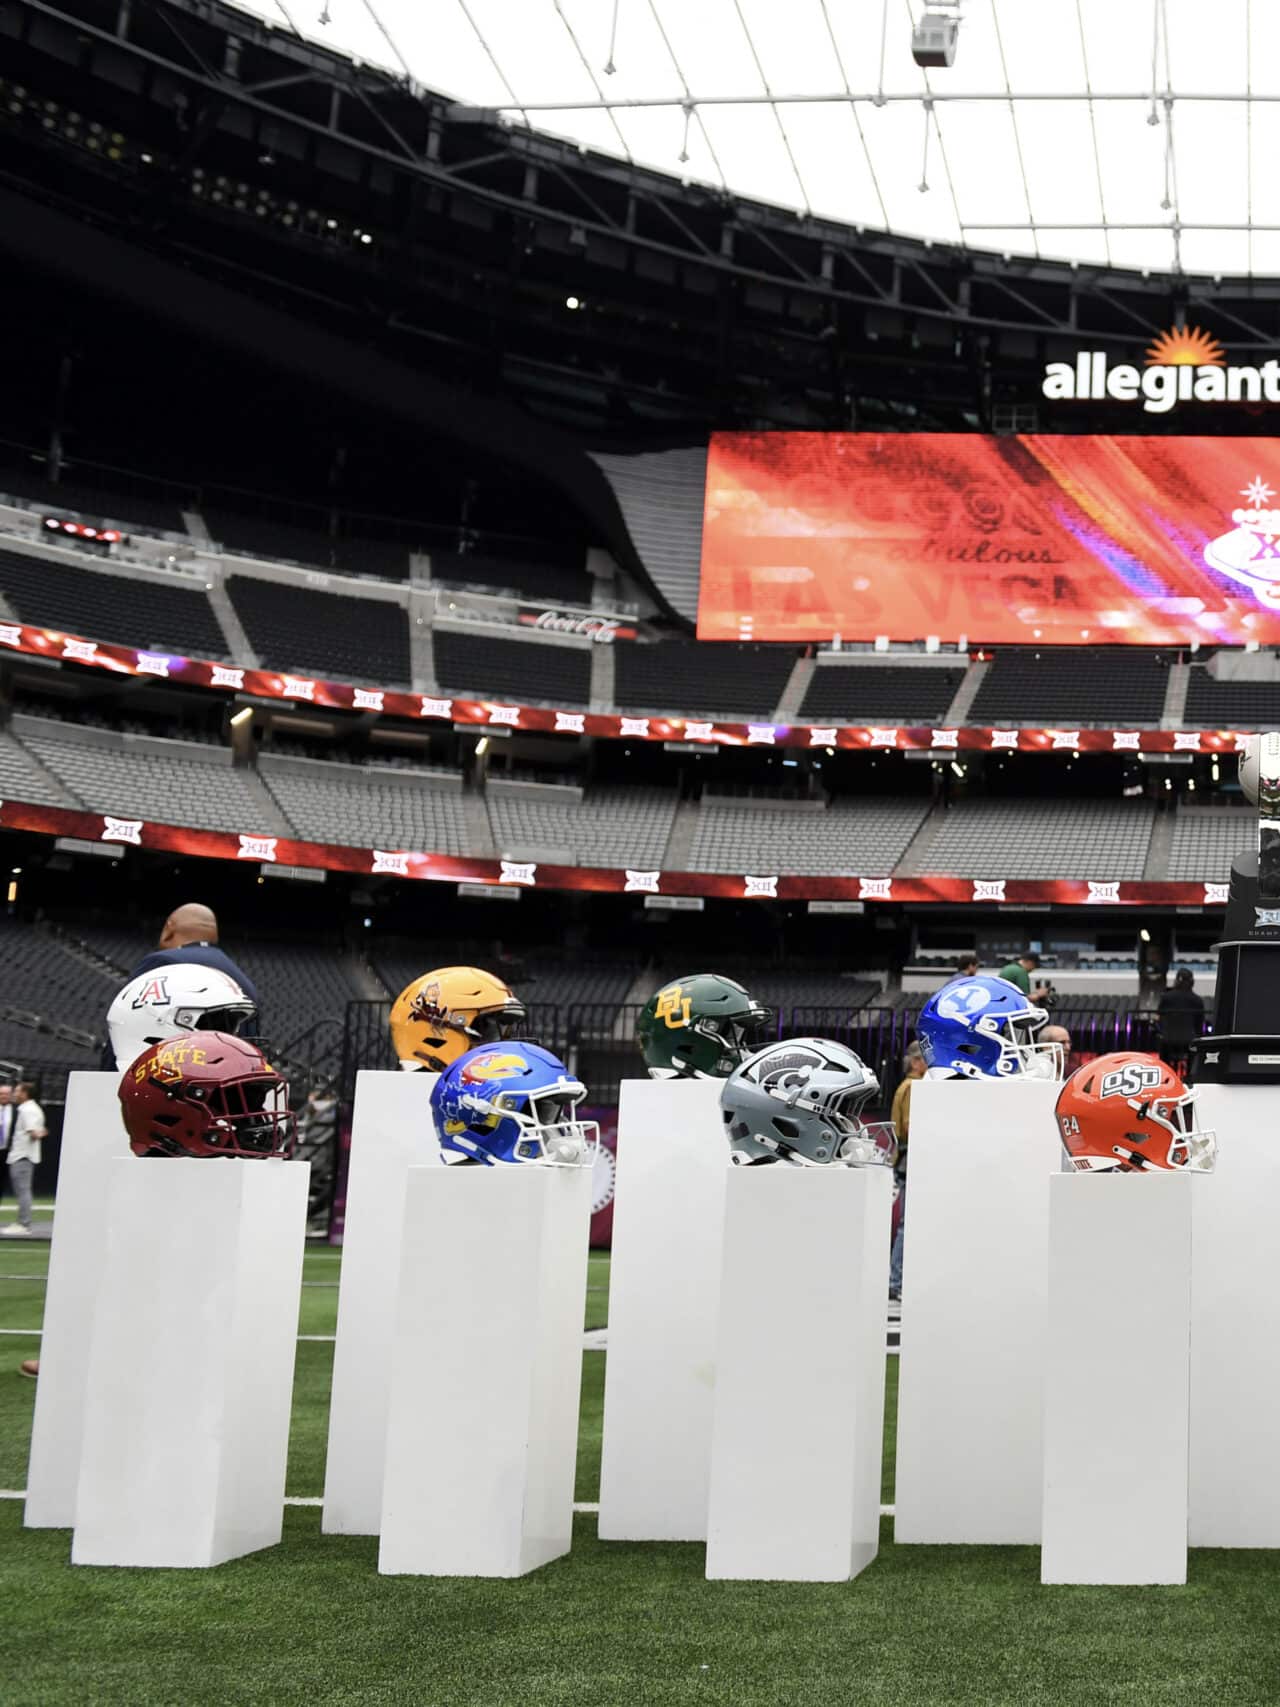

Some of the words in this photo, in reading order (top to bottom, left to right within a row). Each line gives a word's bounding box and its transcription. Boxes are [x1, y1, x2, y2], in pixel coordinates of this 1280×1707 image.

[132, 976, 171, 1010] A
[655, 986, 692, 1029] BU
[946, 988, 981, 1014] Y
[135, 1047, 207, 1084] STATE
[1102, 1064, 1180, 1099] OSU
[1062, 1116, 1080, 1136] 24
